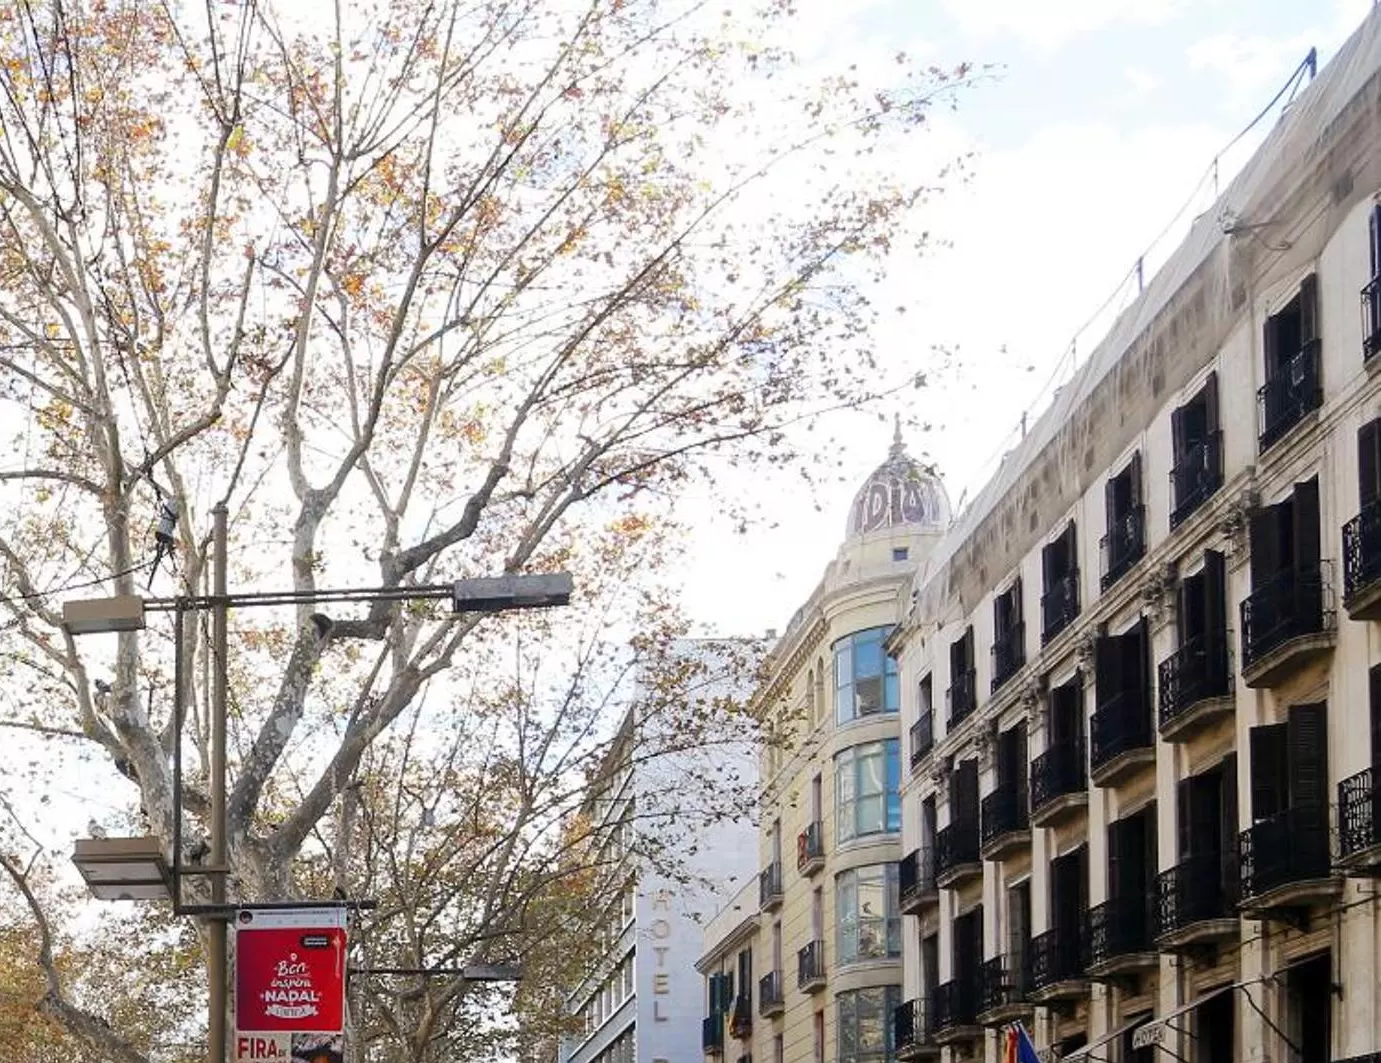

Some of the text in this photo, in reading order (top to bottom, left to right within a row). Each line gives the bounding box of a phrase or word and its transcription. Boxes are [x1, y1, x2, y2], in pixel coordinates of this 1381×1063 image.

[651, 889, 671, 1023] HOTEL
[264, 989, 320, 1002] NADAL
[237, 1037, 278, 1059] FIRA
